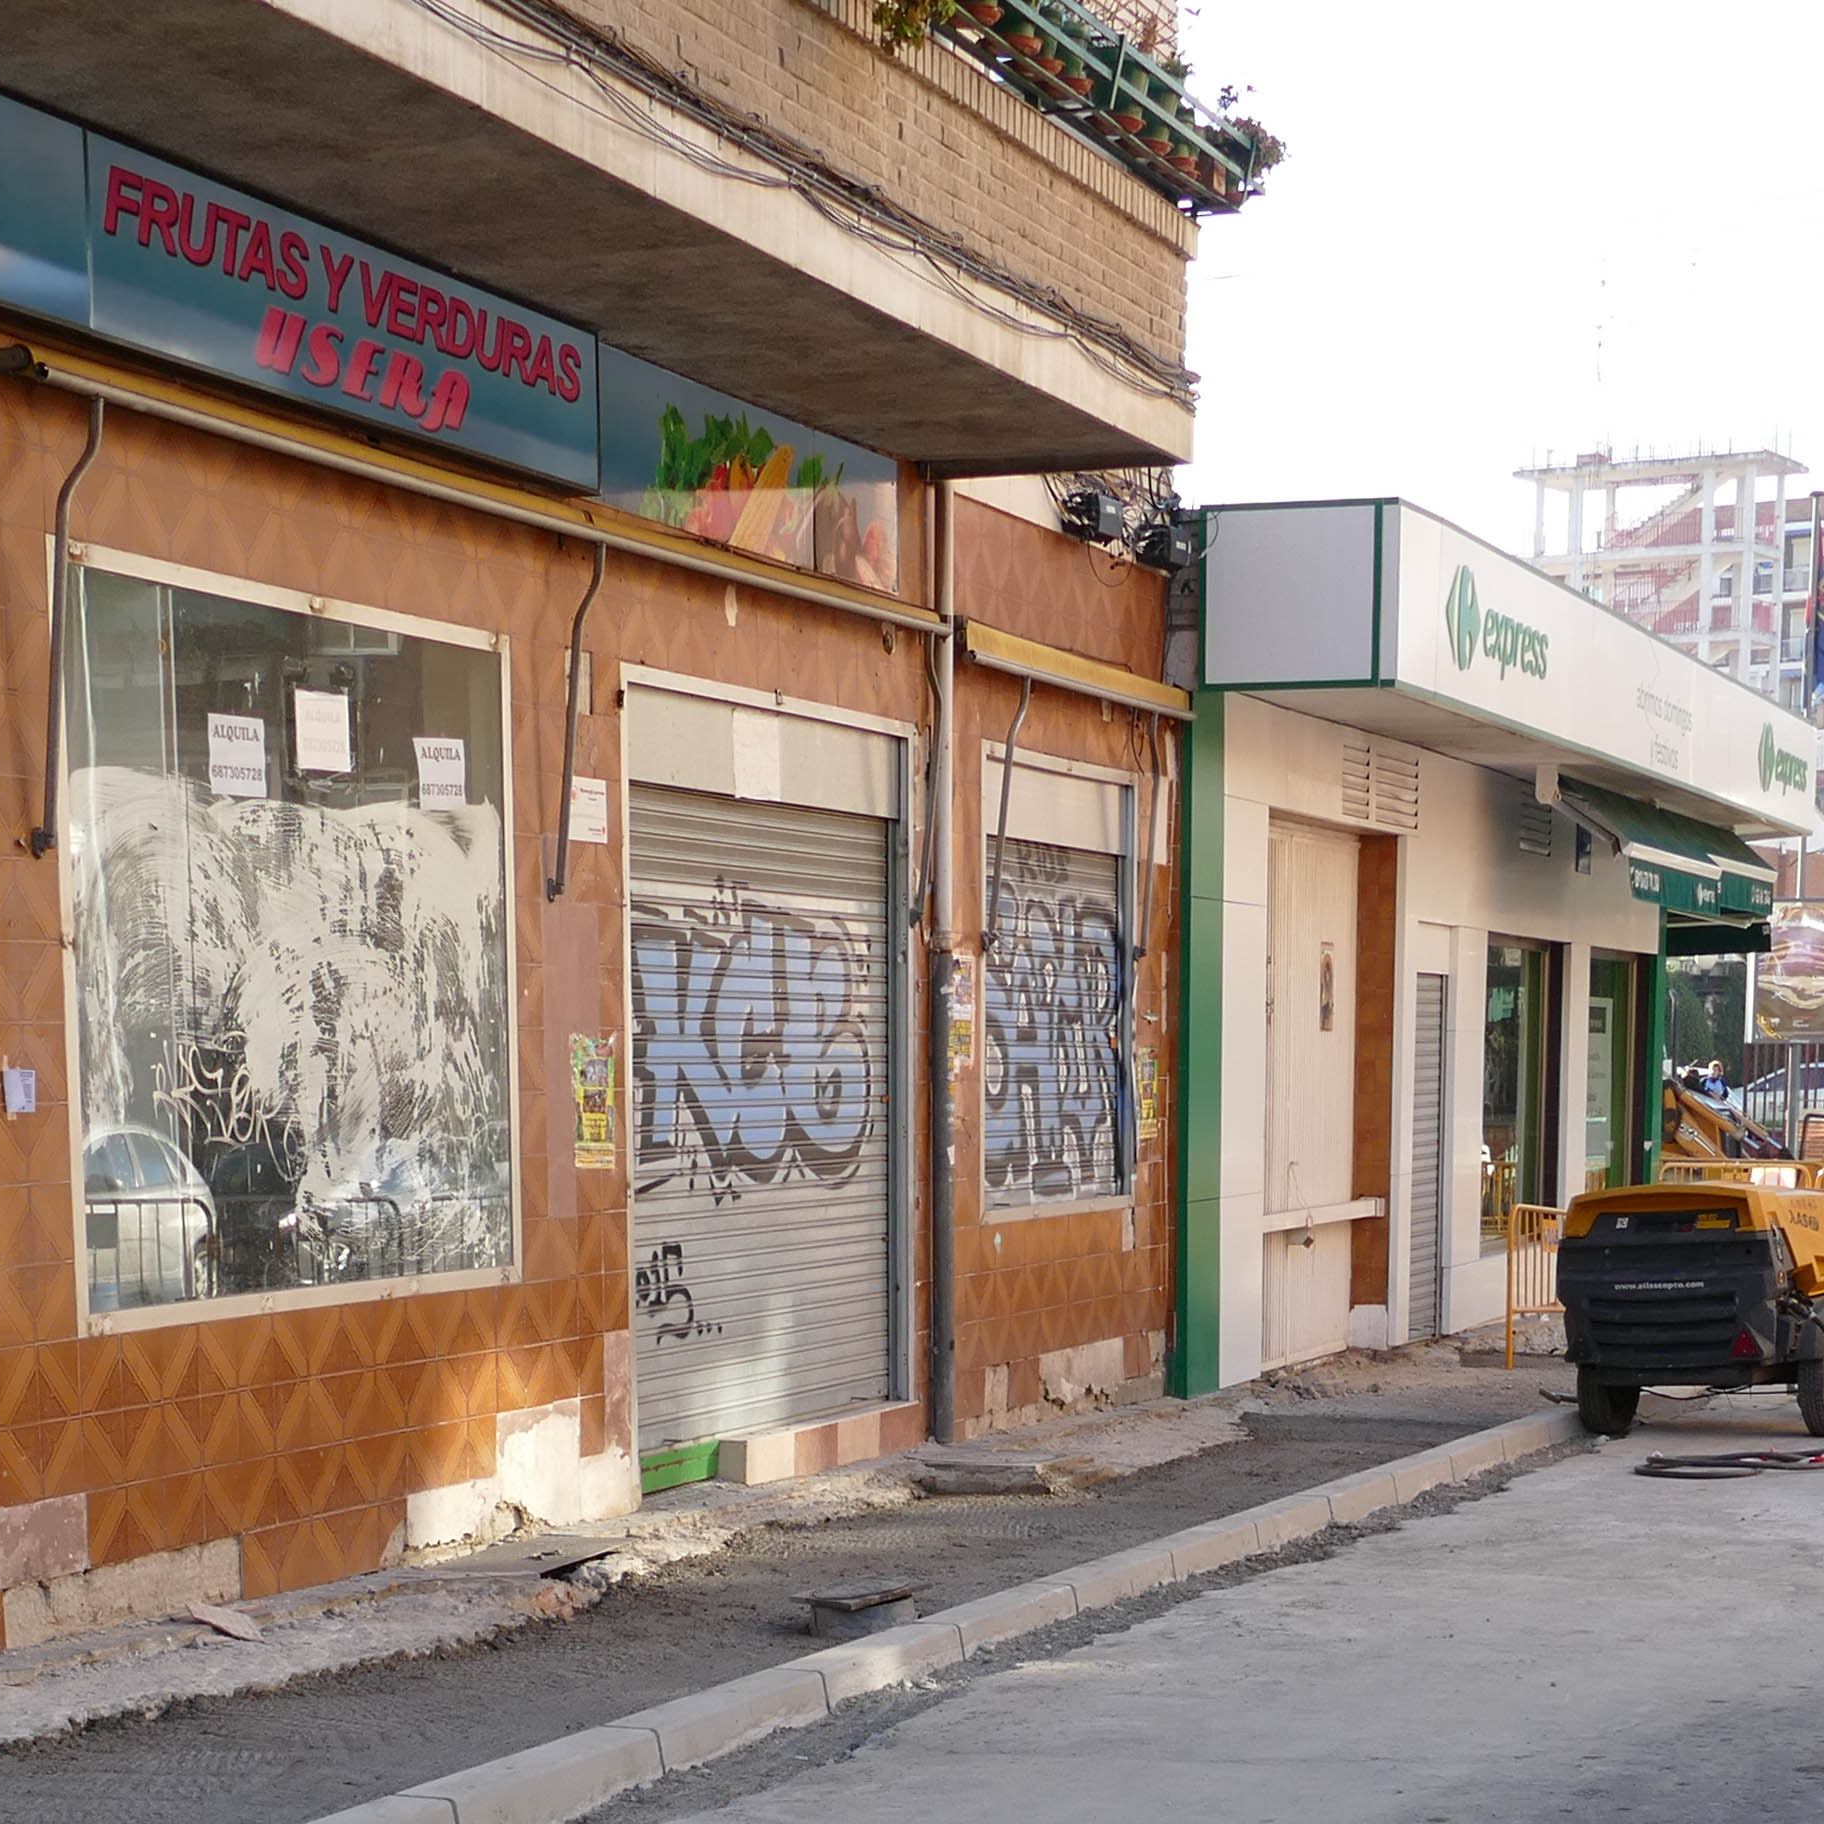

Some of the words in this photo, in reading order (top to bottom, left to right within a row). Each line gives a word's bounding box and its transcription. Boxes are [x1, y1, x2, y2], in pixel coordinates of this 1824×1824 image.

[103, 165, 309, 300] FRUTAS
[320, 244, 354, 313] Y
[359, 260, 582, 402] VERDURAS
[254, 304, 470, 433] USERA
[1483, 608, 1549, 682] express
[212, 723, 260, 743] ALQUILA
[420, 746, 462, 762] ALQUILA
[1775, 746, 1809, 796] express
[211, 764, 263, 782] 687305728
[421, 783, 464, 797] 687305728
